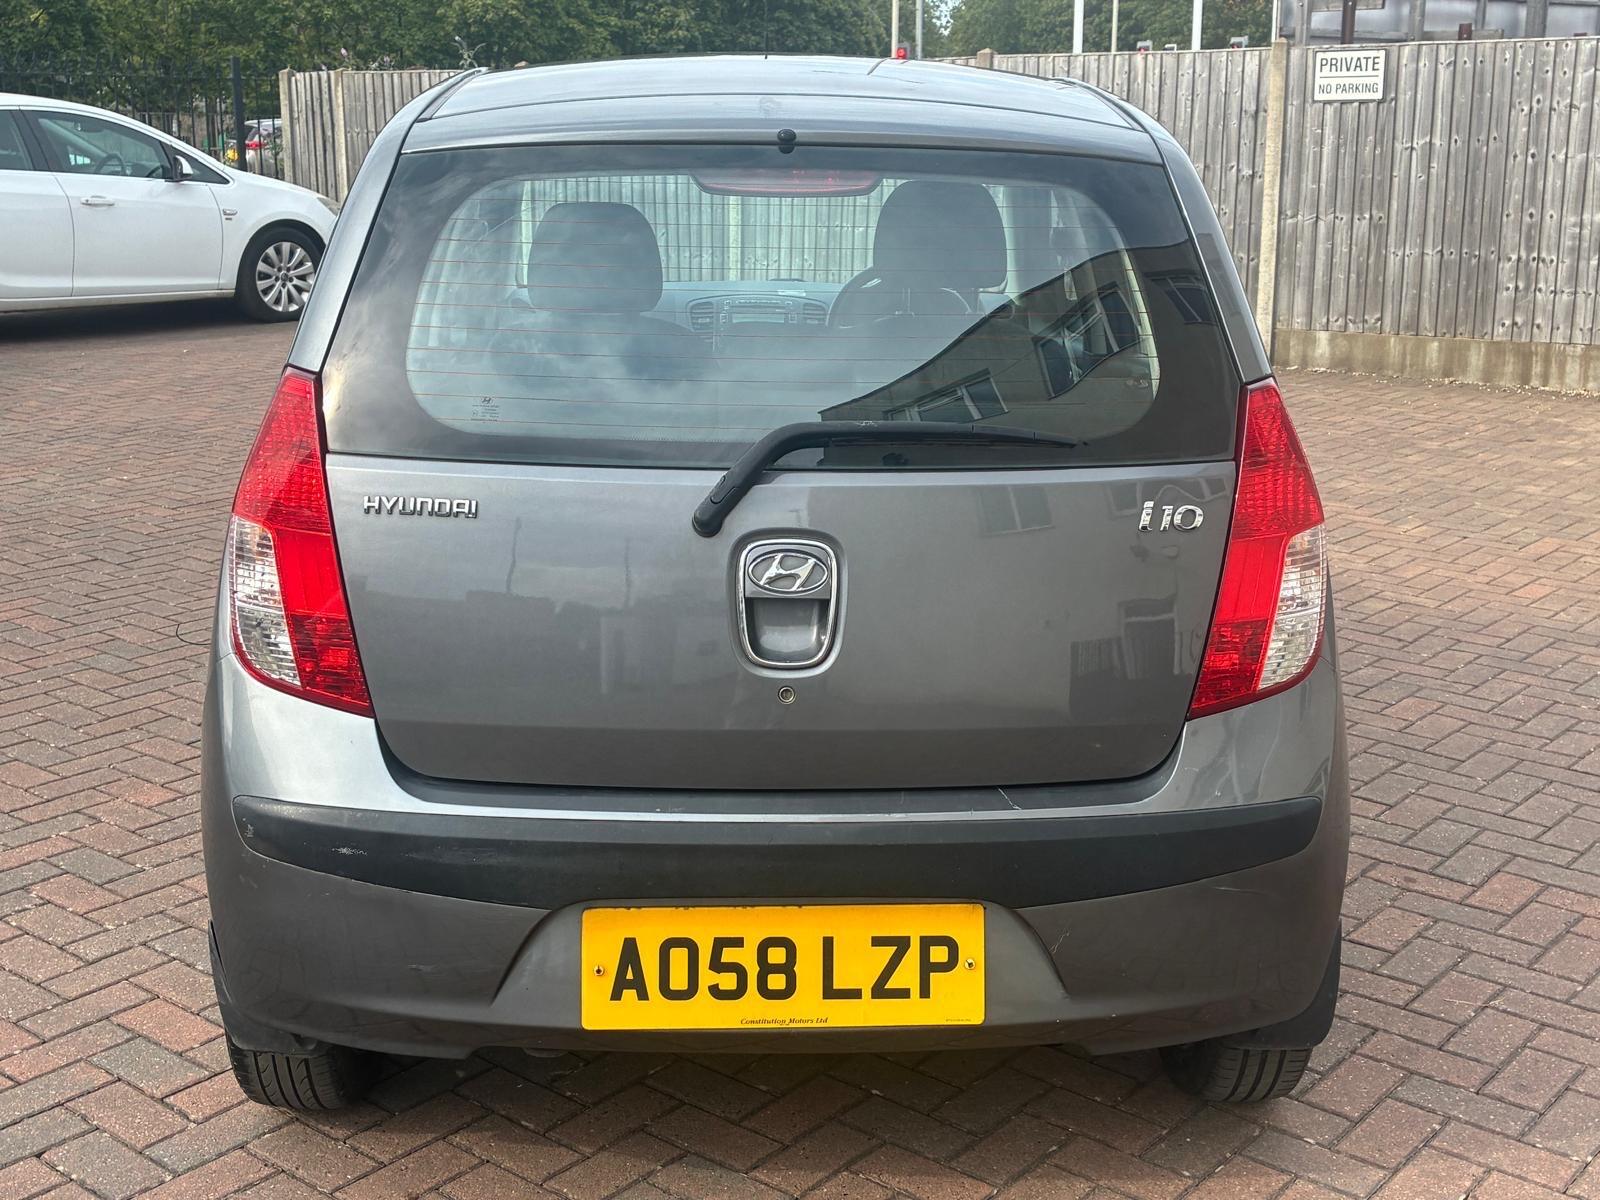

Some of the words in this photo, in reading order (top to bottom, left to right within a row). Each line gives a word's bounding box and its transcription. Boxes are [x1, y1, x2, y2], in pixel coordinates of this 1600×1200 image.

[1319, 56, 1381, 73] PRIVATE
[1318, 83, 1332, 95] NO
[1335, 82, 1379, 94] PARKING
[363, 495, 479, 519] HYUNDAI
[1138, 500, 1204, 532] i10
[609, 936, 797, 1001] AO58
[822, 935, 959, 1001] LZP
[740, 1018, 787, 1026] Constitution
[786, 1017, 814, 1026] Motors
